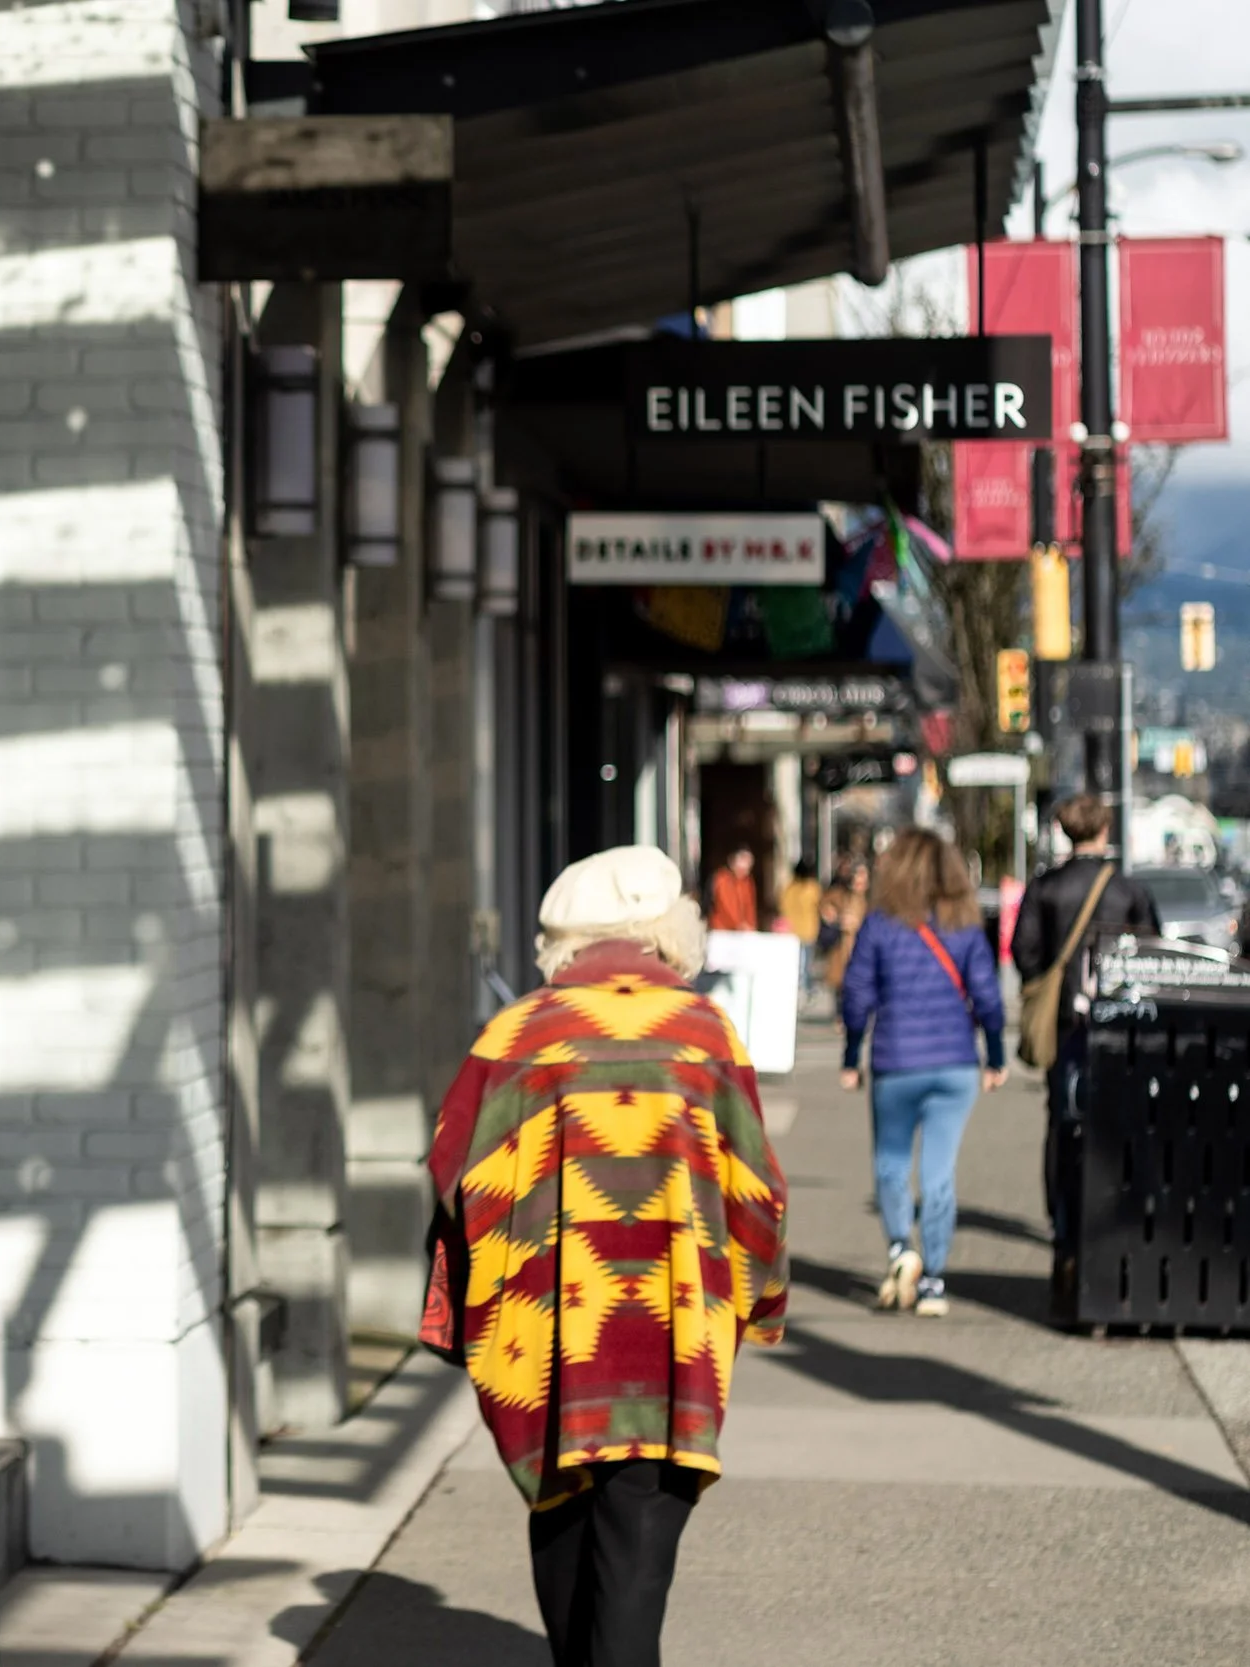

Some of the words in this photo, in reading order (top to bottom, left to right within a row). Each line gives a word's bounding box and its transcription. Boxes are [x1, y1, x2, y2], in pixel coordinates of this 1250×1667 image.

[646, 385, 825, 431] EILEEN
[843, 383, 1028, 430] FISHER
[702, 536, 734, 562] BY
